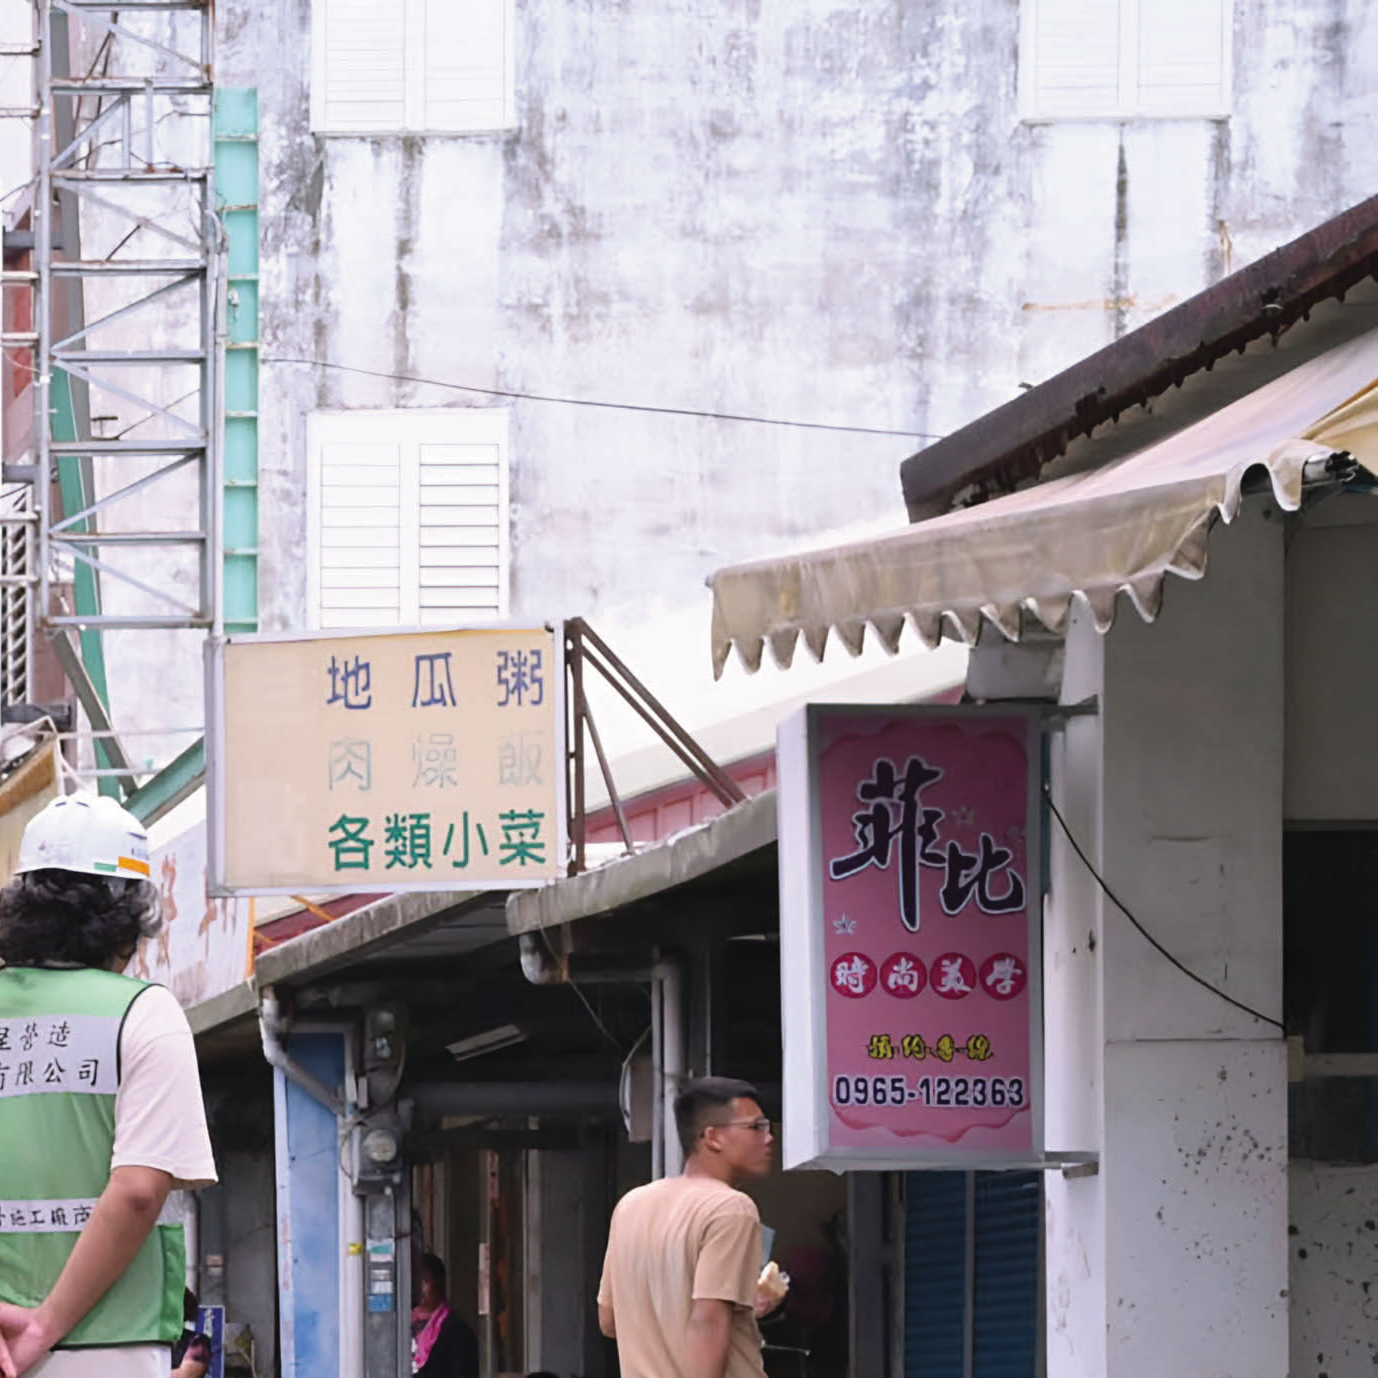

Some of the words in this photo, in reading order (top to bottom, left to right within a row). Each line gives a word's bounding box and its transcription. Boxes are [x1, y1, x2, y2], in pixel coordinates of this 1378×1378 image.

[326, 649, 544, 710] 地瓜粥
[328, 731, 544, 791] 肉燥飯
[327, 808, 546, 871] 各類小菜
[829, 754, 1028, 933] 菲比
[834, 1076, 1025, 1106] 0965-122363
